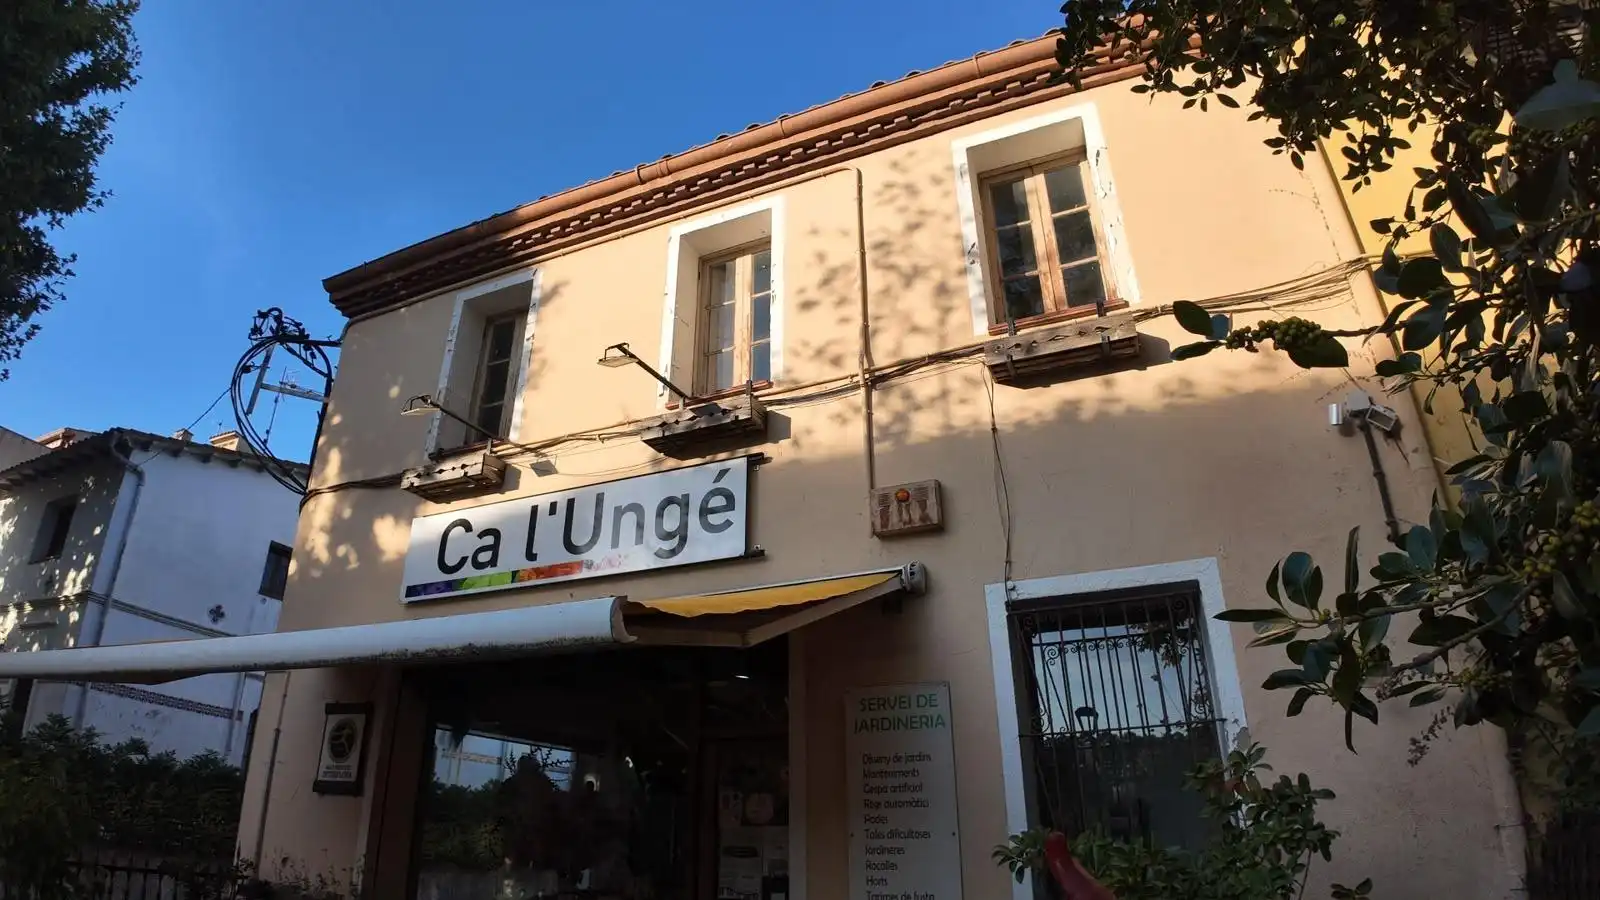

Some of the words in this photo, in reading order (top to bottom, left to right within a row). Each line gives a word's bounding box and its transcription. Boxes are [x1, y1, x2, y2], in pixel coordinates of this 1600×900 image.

[437, 518, 501, 575] Ca
[524, 468, 737, 562] l'Ungé
[859, 695, 912, 712] SERVEI
[916, 694, 939, 708] DE
[854, 714, 946, 734] JARDINERIA
[893, 752, 904, 763] de
[904, 752, 932, 764] jardins
[890, 781, 923, 793] artificial
[866, 875, 888, 886] Horts
[901, 890, 912, 900] de
